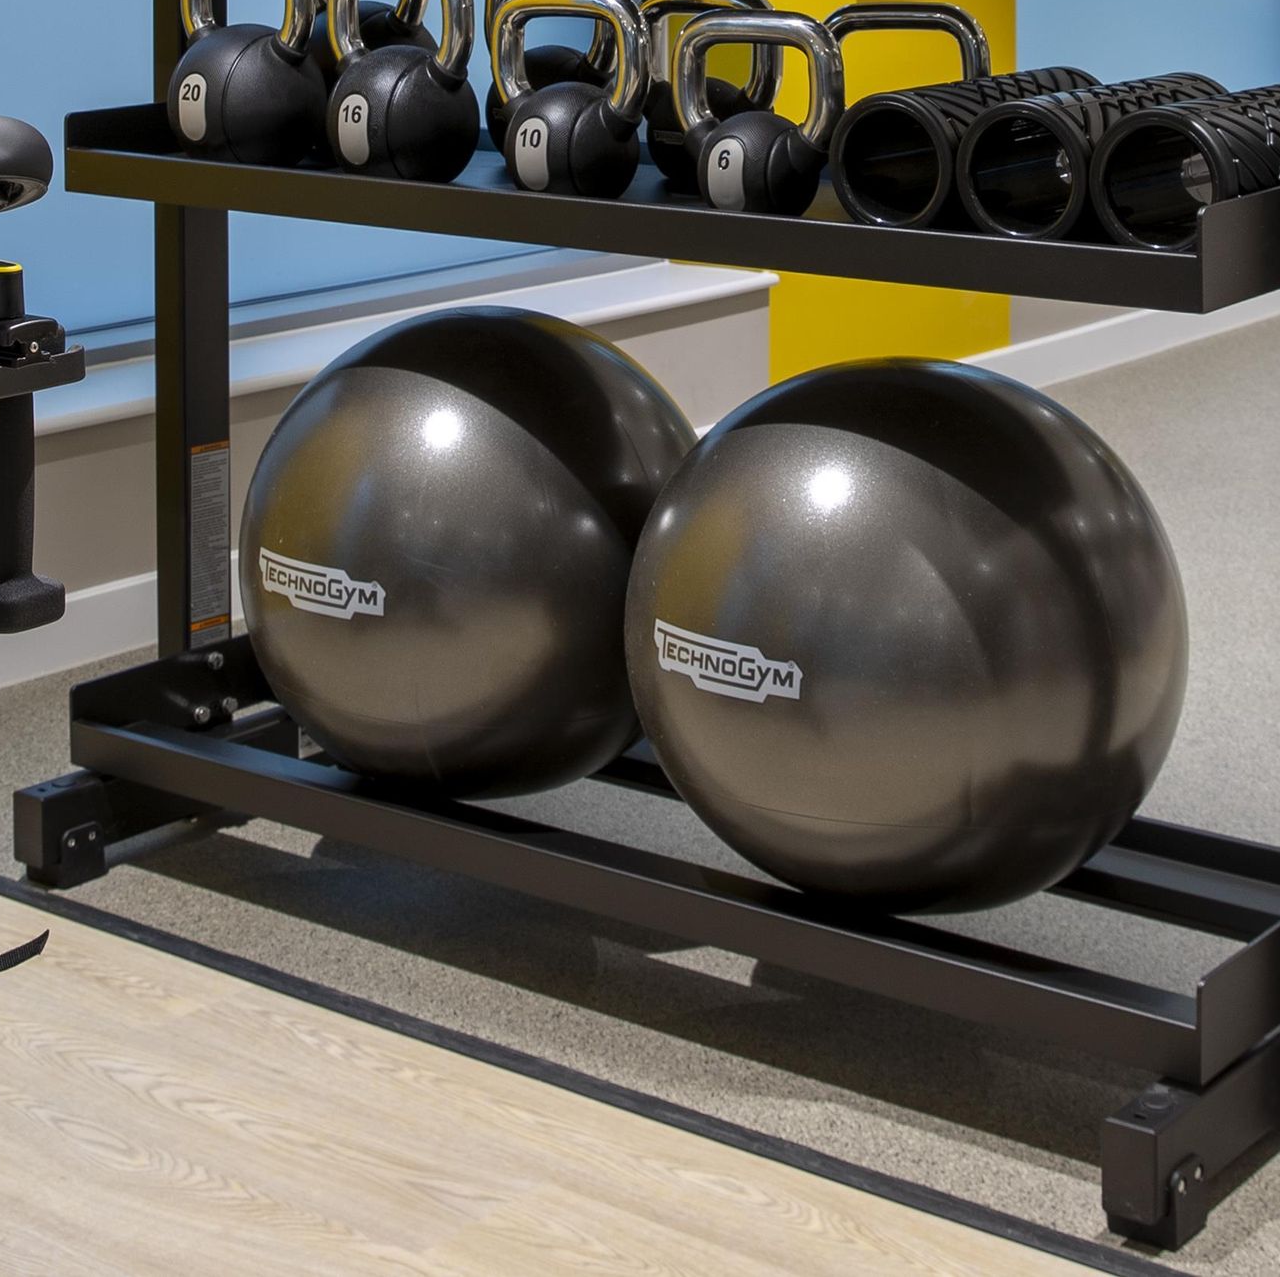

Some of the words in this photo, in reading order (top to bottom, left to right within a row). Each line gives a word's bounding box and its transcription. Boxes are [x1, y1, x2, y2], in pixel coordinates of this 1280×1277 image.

[181, 83, 201, 102] 20
[342, 104, 362, 124] 16
[520, 128, 542, 149] 10
[717, 149, 731, 171] 6
[261, 553, 378, 611] TECHNOGYM
[656, 626, 797, 693] TECHNOGYM
